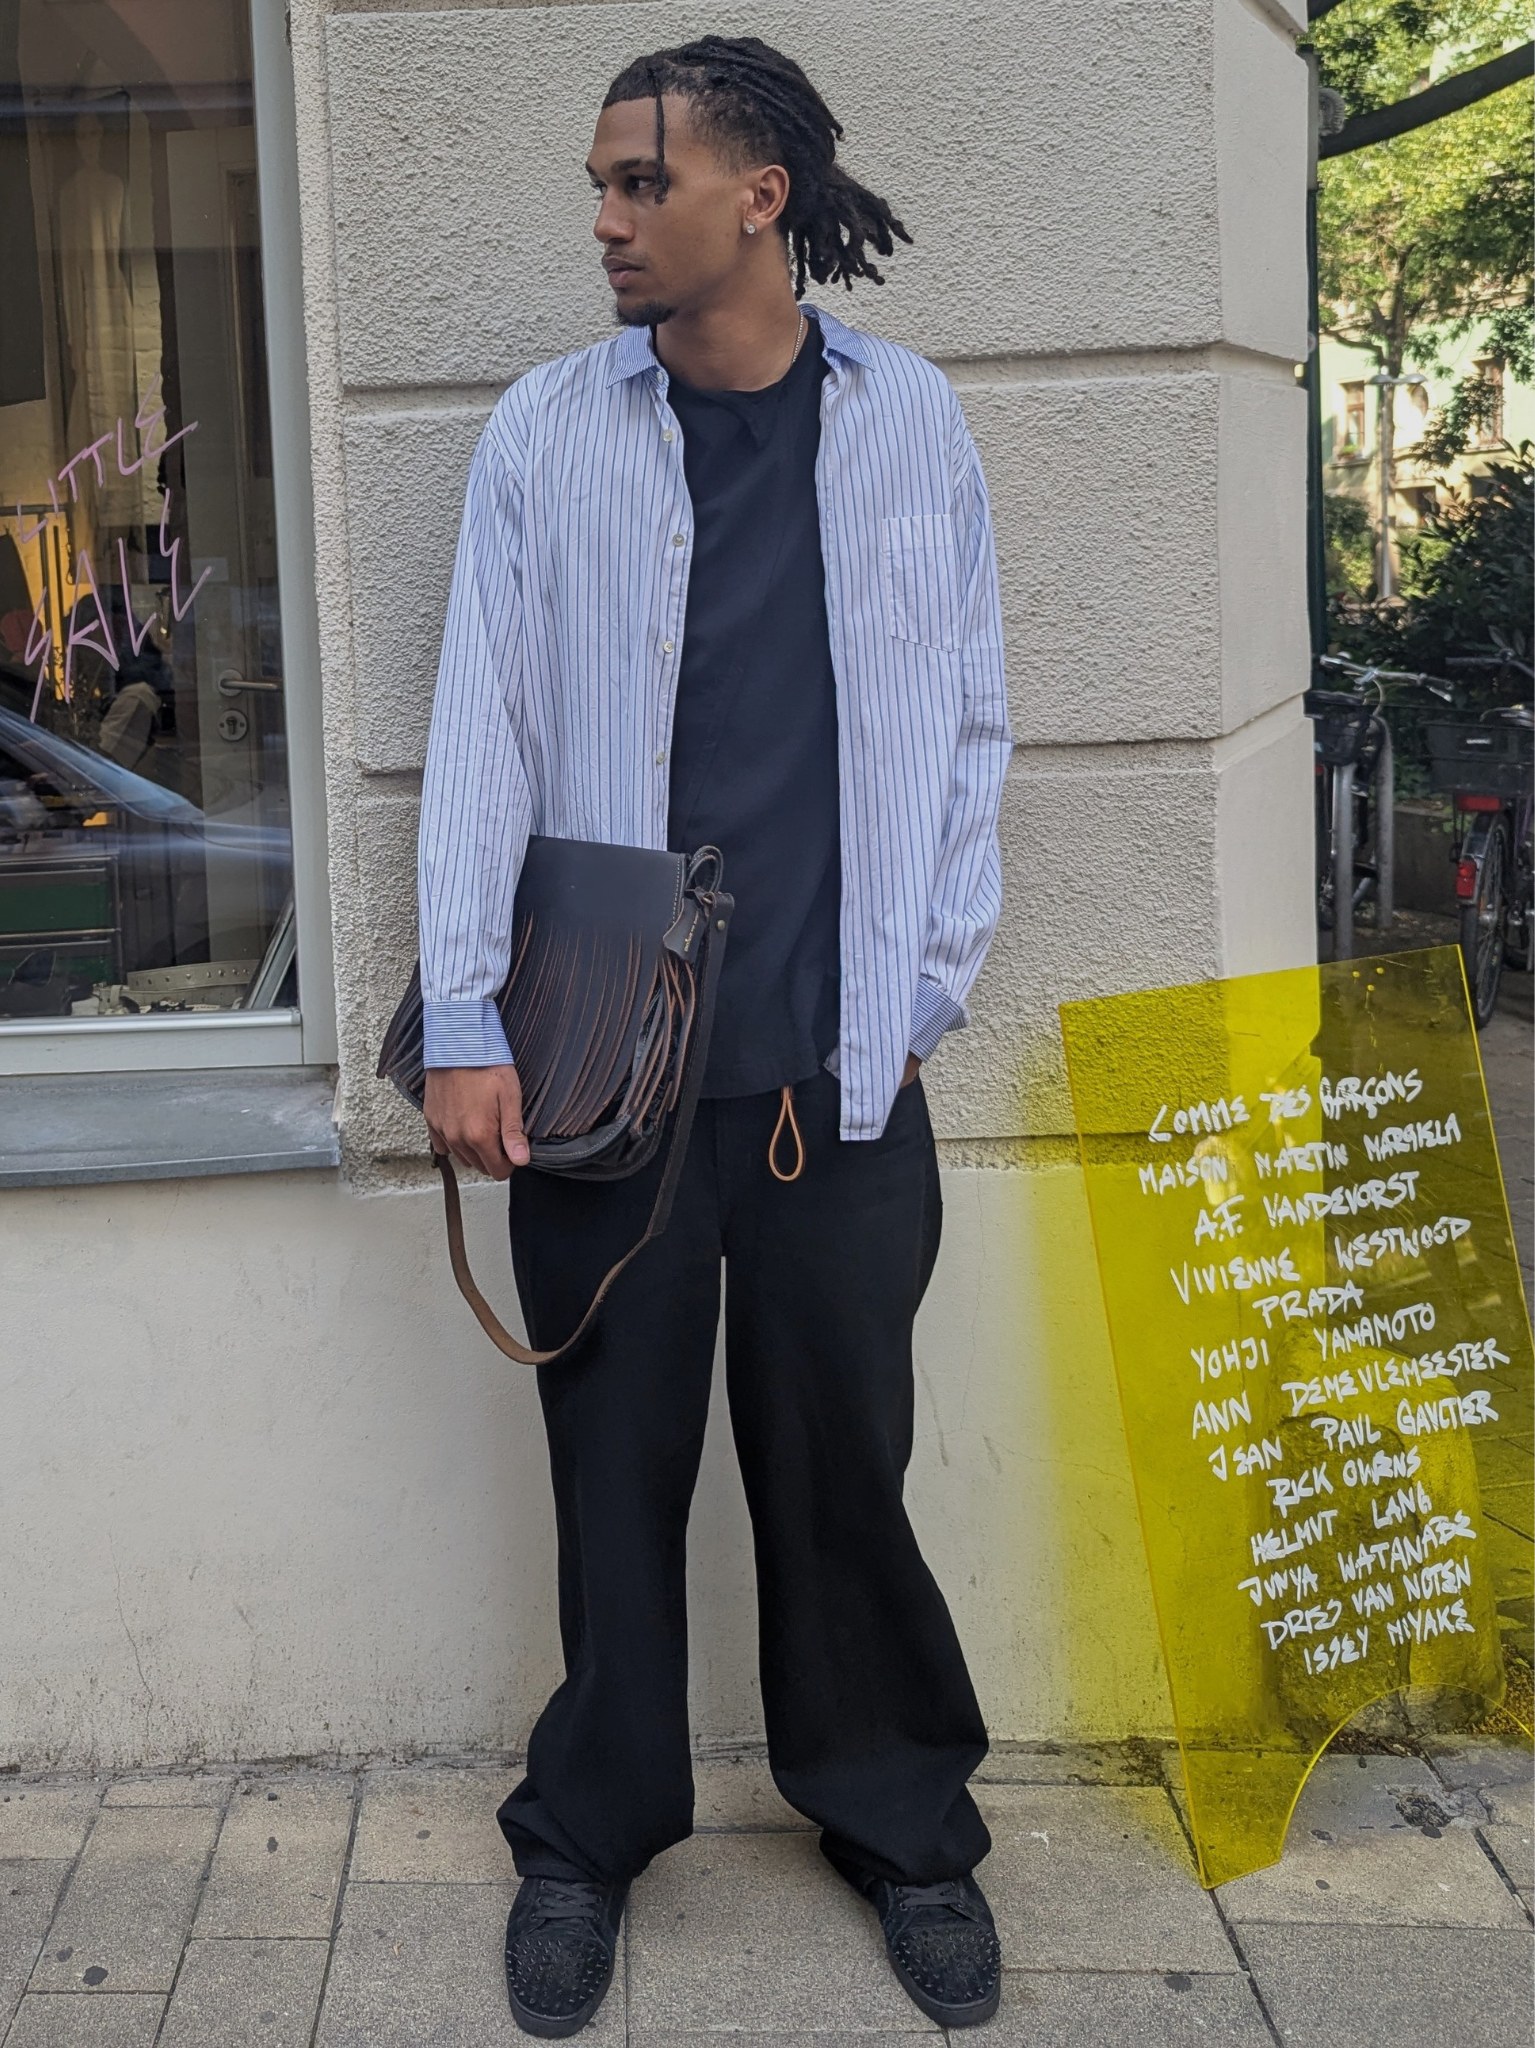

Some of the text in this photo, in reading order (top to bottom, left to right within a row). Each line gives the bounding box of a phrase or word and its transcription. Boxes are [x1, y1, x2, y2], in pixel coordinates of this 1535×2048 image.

[17, 374, 198, 543] LITTLE
[25, 488, 213, 723] SALE
[1149, 1096, 1249, 1143] COMME
[1259, 1086, 1312, 1122] DES
[1138, 1157, 1228, 1195] MAISON
[1254, 1141, 1350, 1179] MARTIN
[1262, 1170, 1420, 1228] VANDEVORST
[1170, 1216, 1471, 1305] VIVIENNE WESTWOOD
[1253, 1279, 1364, 1329] PRADA
[1190, 1302, 1436, 1381] YOHJI YAMAMOTO
[1192, 1390, 1252, 1439] ANN
[1208, 1437, 1283, 1481] JEAN
[1266, 1446, 1422, 1519] RICK OWENS
[1371, 1481, 1433, 1530] LANG
[1337, 1510, 1477, 1583] WATANABE
[1260, 1556, 1472, 1650] DRIES VAN NOTEN
[1303, 1598, 1475, 1675] ISSEY MIYAKE
